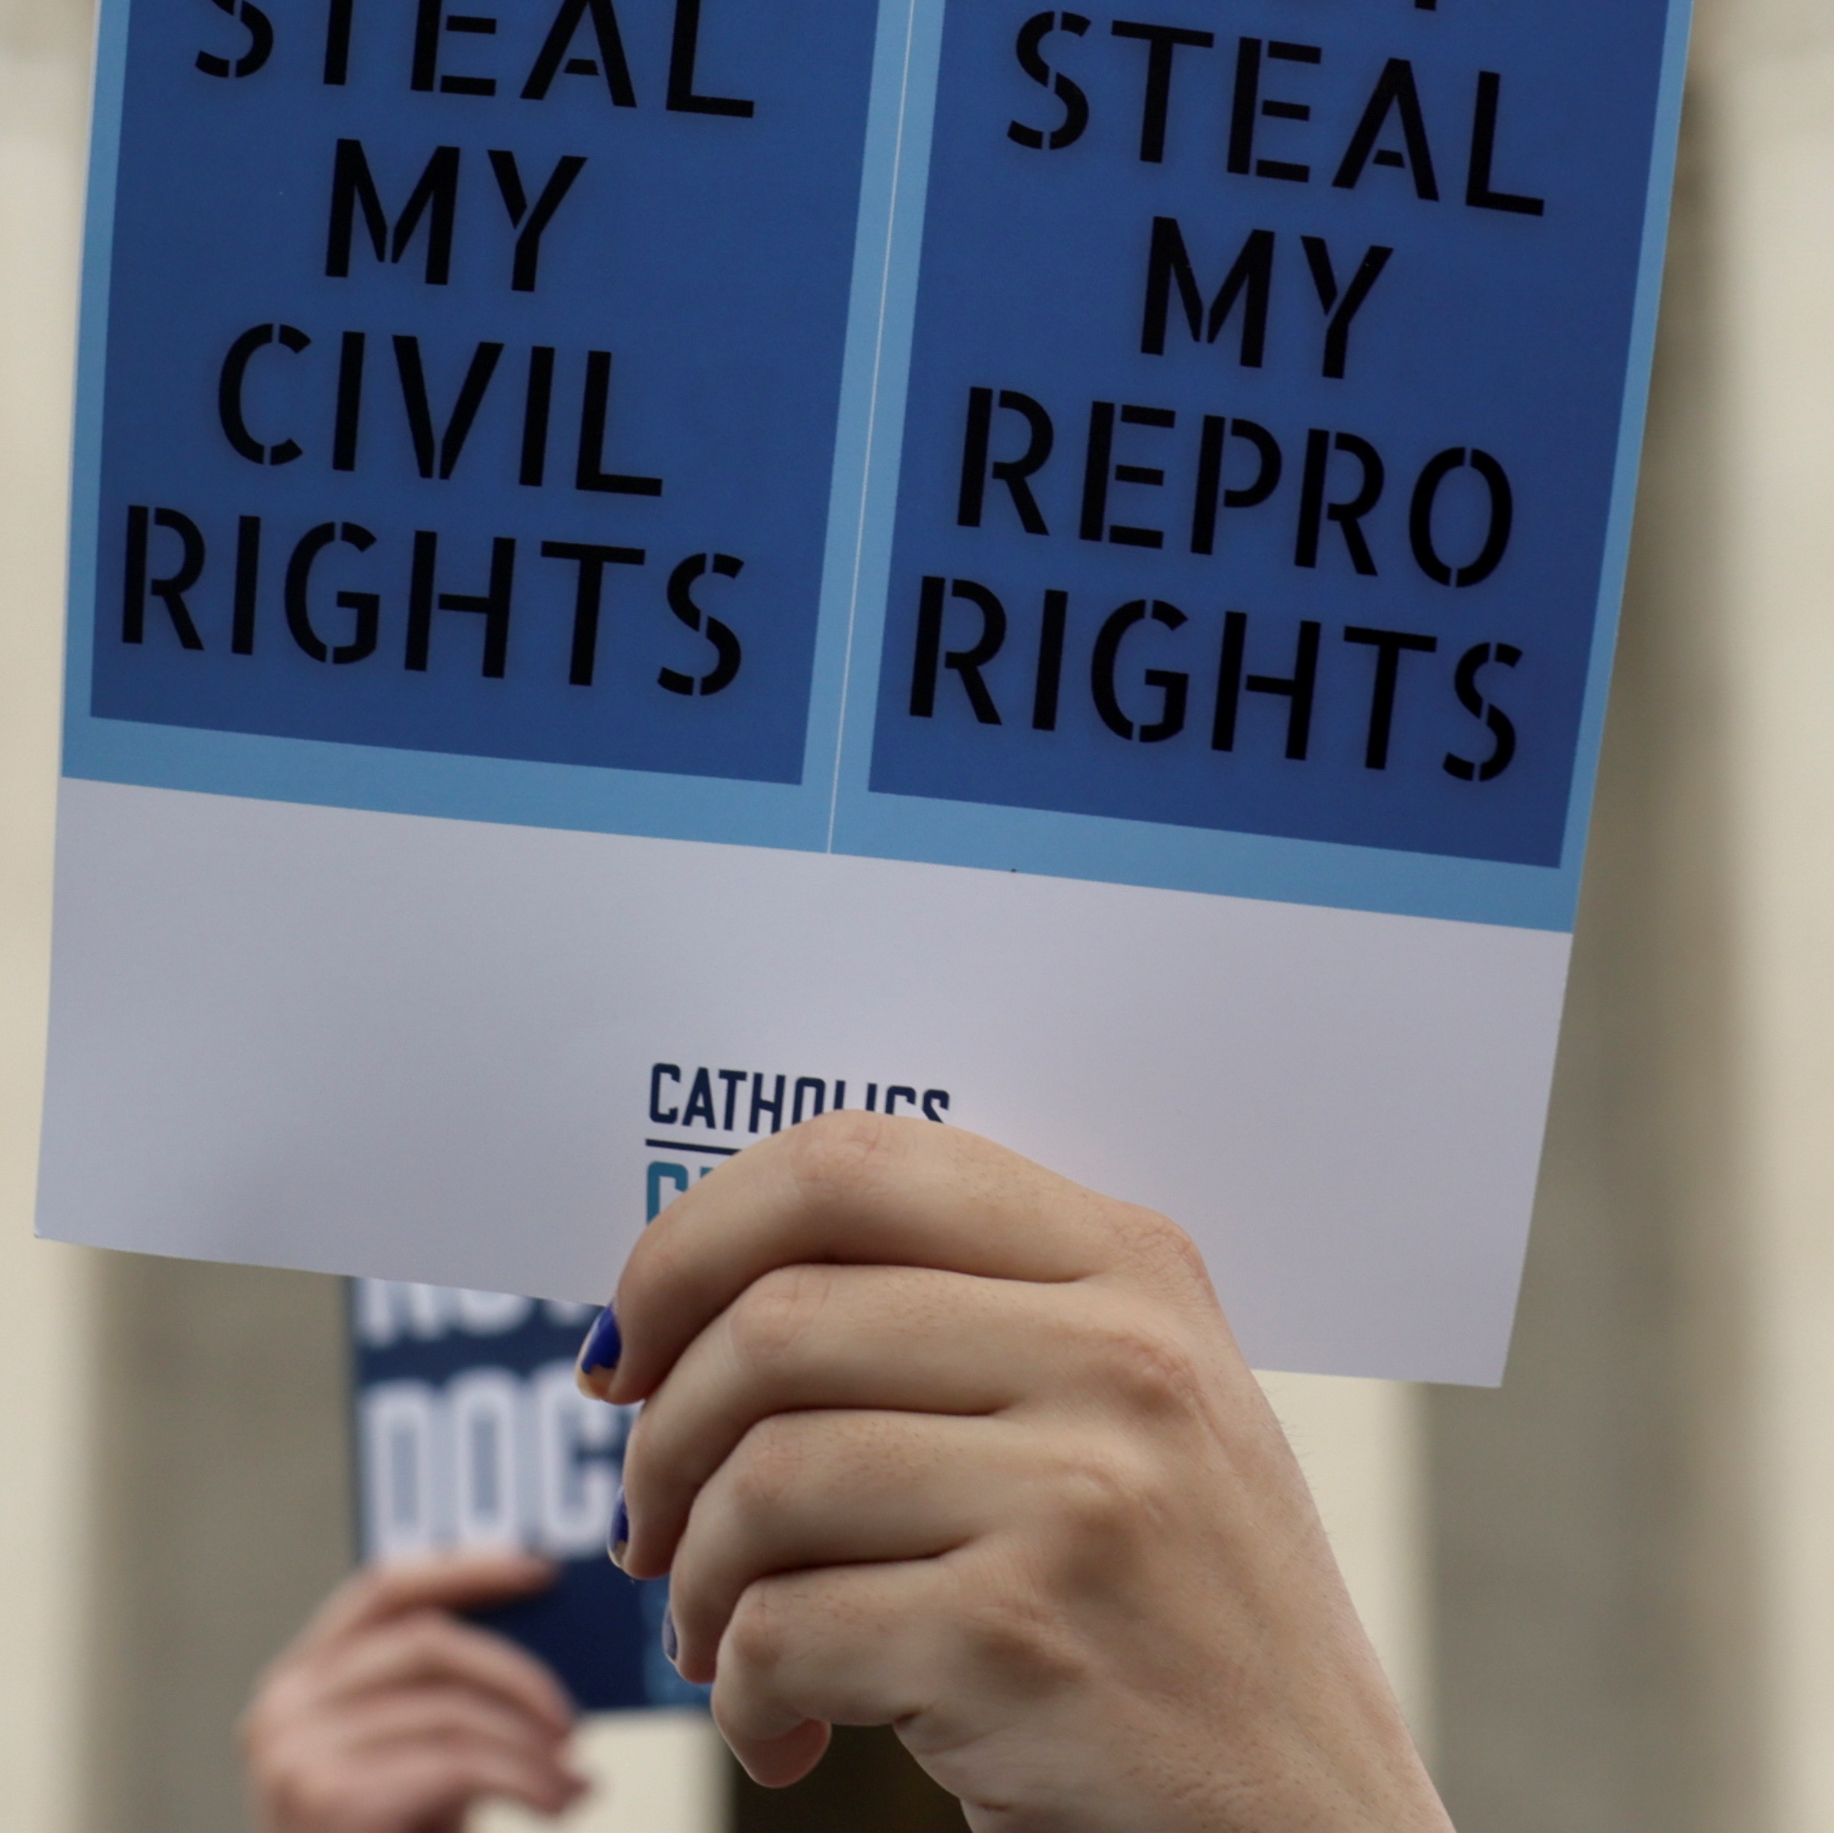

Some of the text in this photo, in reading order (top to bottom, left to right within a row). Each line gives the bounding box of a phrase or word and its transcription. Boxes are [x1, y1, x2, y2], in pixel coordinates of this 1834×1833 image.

[1007, 11, 1544, 216] STEAL
[325, 138, 588, 292] MY
[1140, 216, 1393, 379] MY
[218, 323, 663, 496] CIVIL
[957, 387, 1513, 588] REPRO
[122, 505, 744, 696] RIGHTS
[909, 576, 1523, 782] RIGHTS
